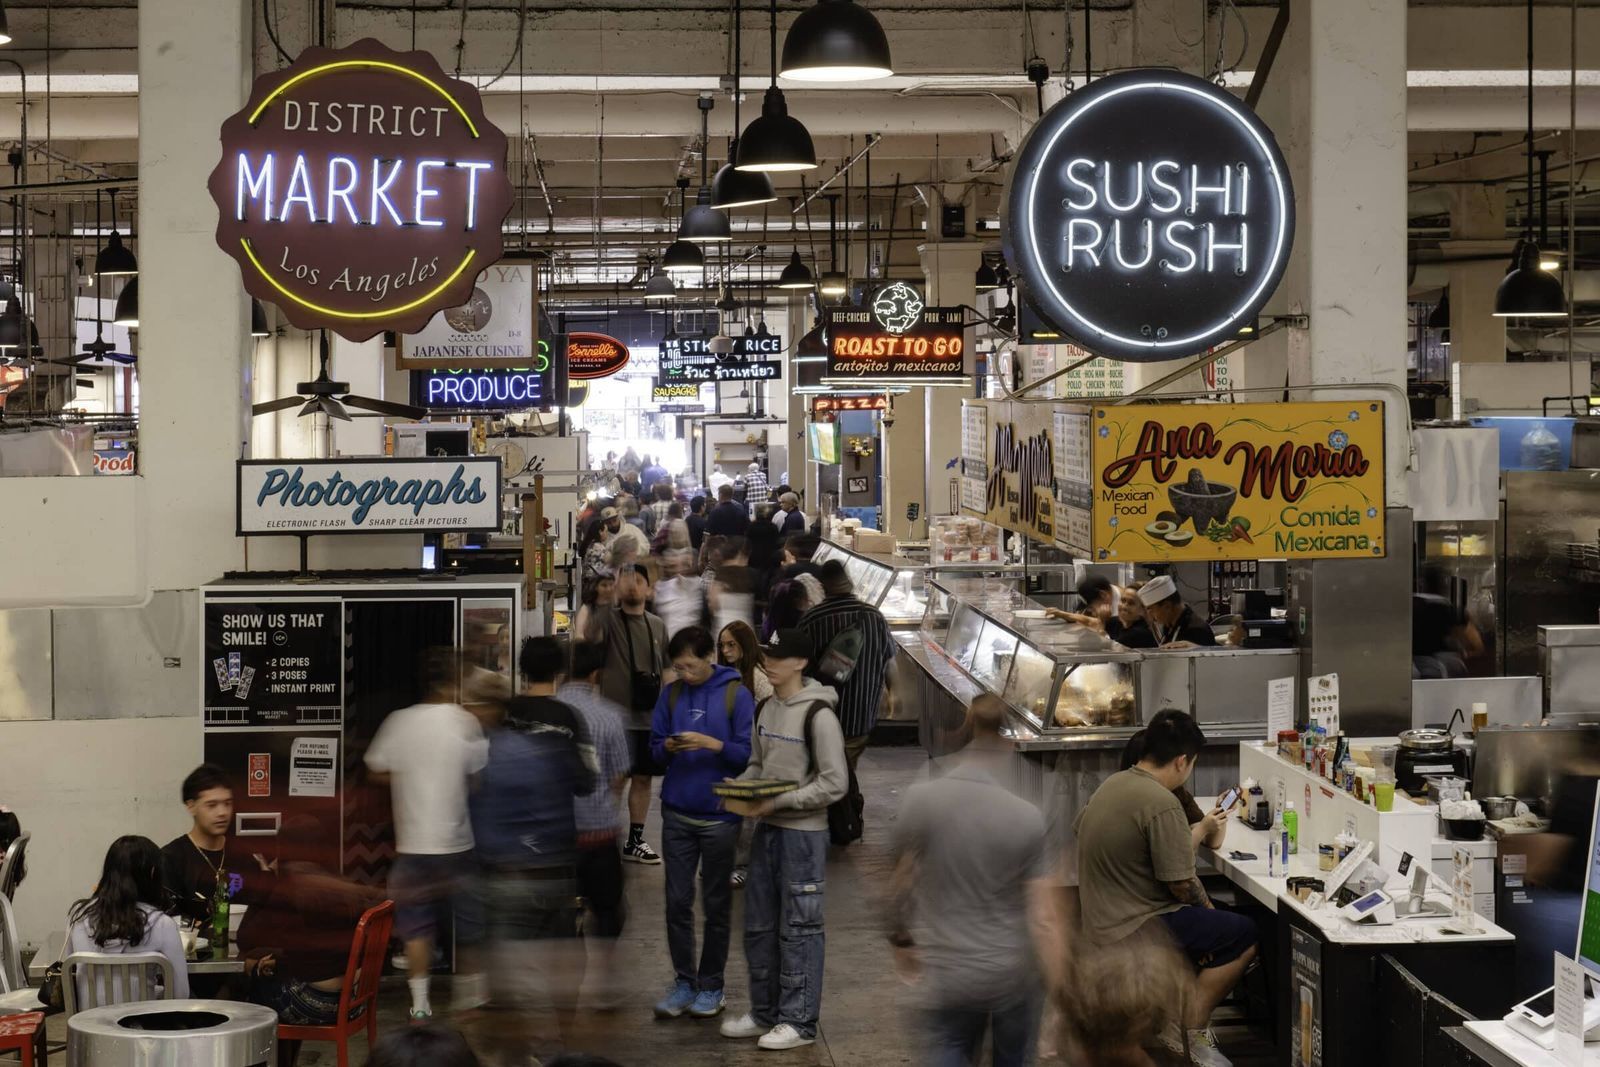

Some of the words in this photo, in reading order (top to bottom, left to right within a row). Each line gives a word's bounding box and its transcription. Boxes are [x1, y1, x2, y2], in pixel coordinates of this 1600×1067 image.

[284, 100, 449, 137] DISTRICT
[237, 152, 492, 229] MARKET
[1066, 158, 1249, 216] SUSHI
[1068, 217, 1248, 273] RUSH
[279, 246, 320, 285] Los
[328, 256, 440, 302] Angeles
[924, 312, 939, 323] PORK
[412, 344, 473, 358] JAPANESE
[475, 343, 524, 357] CUISINE
[745, 339, 780, 351] RICE
[834, 336, 899, 356] ROAST
[902, 337, 928, 356] TO
[933, 336, 962, 356] GO
[834, 359, 889, 376] antojitos
[893, 359, 961, 372] mexicanos
[429, 374, 541, 403] PRODUCE
[816, 398, 887, 411] PIZZA
[1102, 420, 1222, 488] Ana
[1223, 432, 1369, 502] Maria
[256, 463, 487, 526] Photographs
[1102, 488, 1155, 504] Mexican
[1113, 502, 1147, 516] Food
[1279, 505, 1360, 528] Comida
[266, 518, 318, 529] ELECTRONIC
[319, 518, 347, 528] FLASH
[368, 517, 397, 527] SHARP
[398, 517, 427, 528] CLEAR
[427, 516, 468, 526] PICTURES
[1274, 530, 1370, 552] Mexicana
[222, 613, 264, 629] SHOW
[267, 613, 286, 628] US
[290, 613, 325, 628] THAT
[222, 631, 267, 646] SMILE!
[271, 658, 277, 667] 2
[279, 657, 310, 667] COPIES
[271, 671, 277, 680] 3
[279, 670, 307, 680] POSES
[271, 683, 308, 694] INSTANT
[309, 683, 336, 693] PRINT
